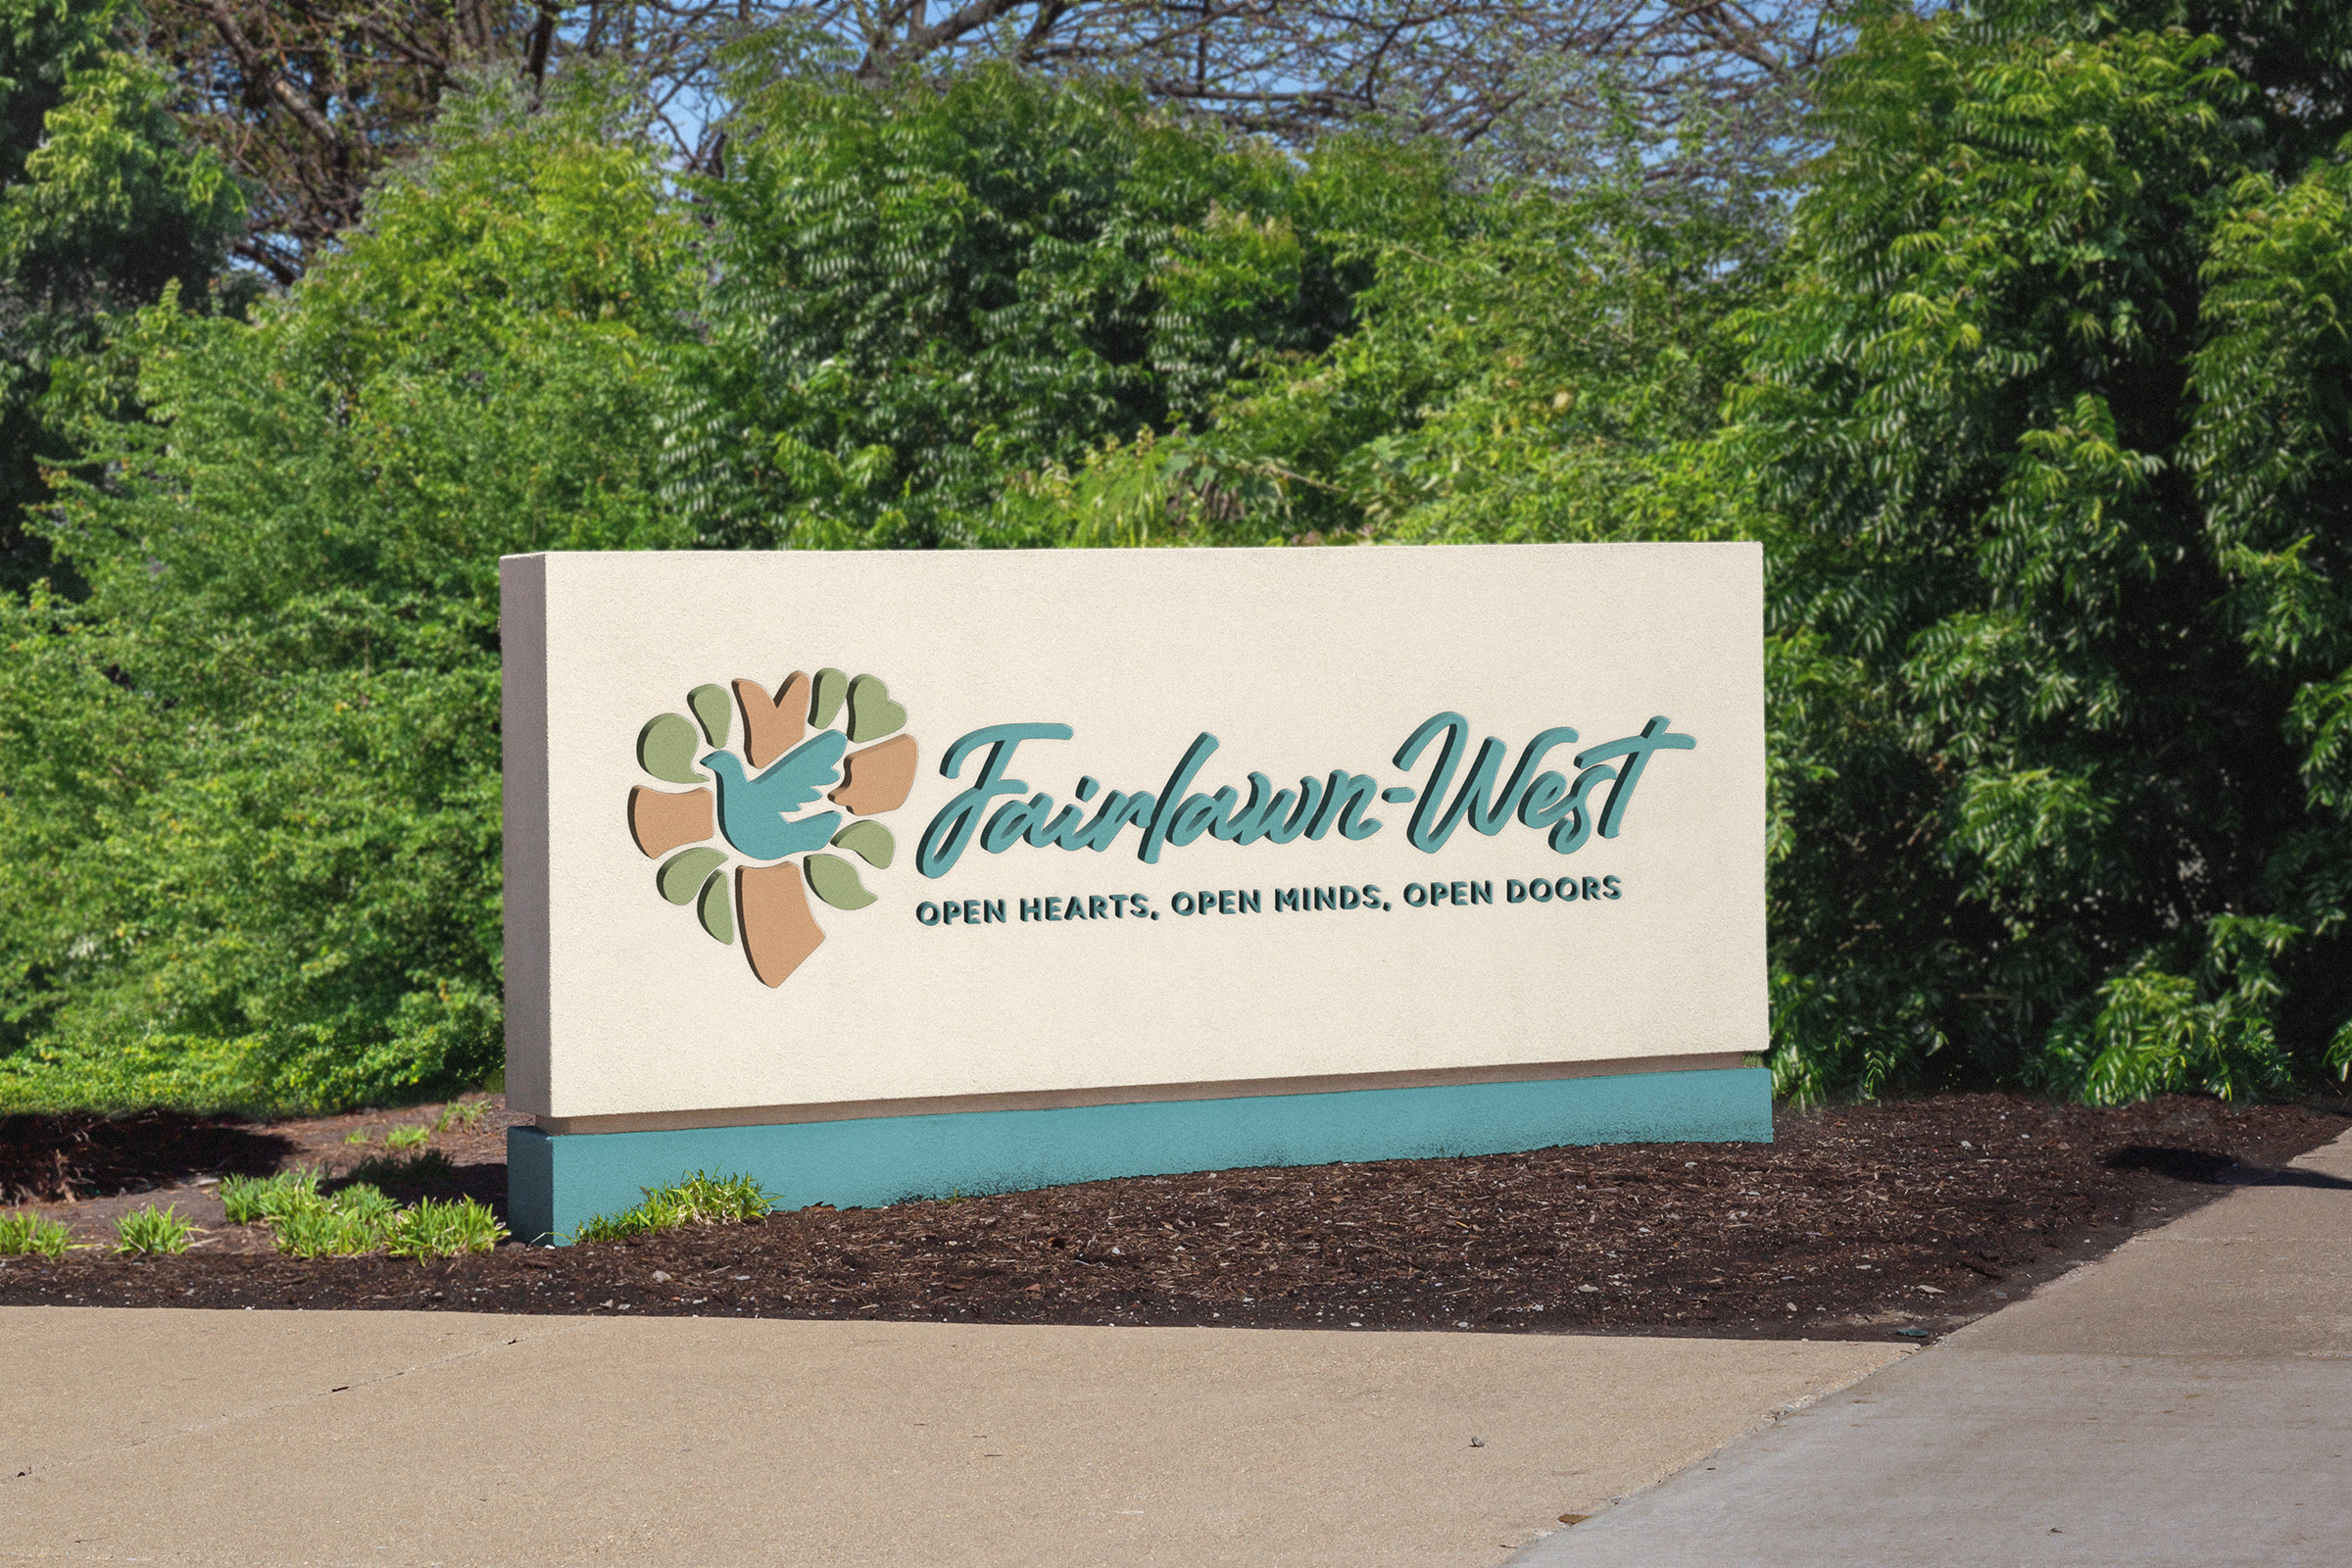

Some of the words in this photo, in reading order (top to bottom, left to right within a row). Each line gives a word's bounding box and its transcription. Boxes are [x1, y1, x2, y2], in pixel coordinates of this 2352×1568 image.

[915, 710, 1696, 879] Fairlawn-West
[915, 899, 1006, 927] OPEN
[1019, 893, 1160, 923] HEARTS,
[1170, 889, 1261, 917] OPEN
[1274, 884, 1393, 913] MINDS,
[1402, 879, 1494, 908] OPEN
[1505, 874, 1622, 905] DOORS
